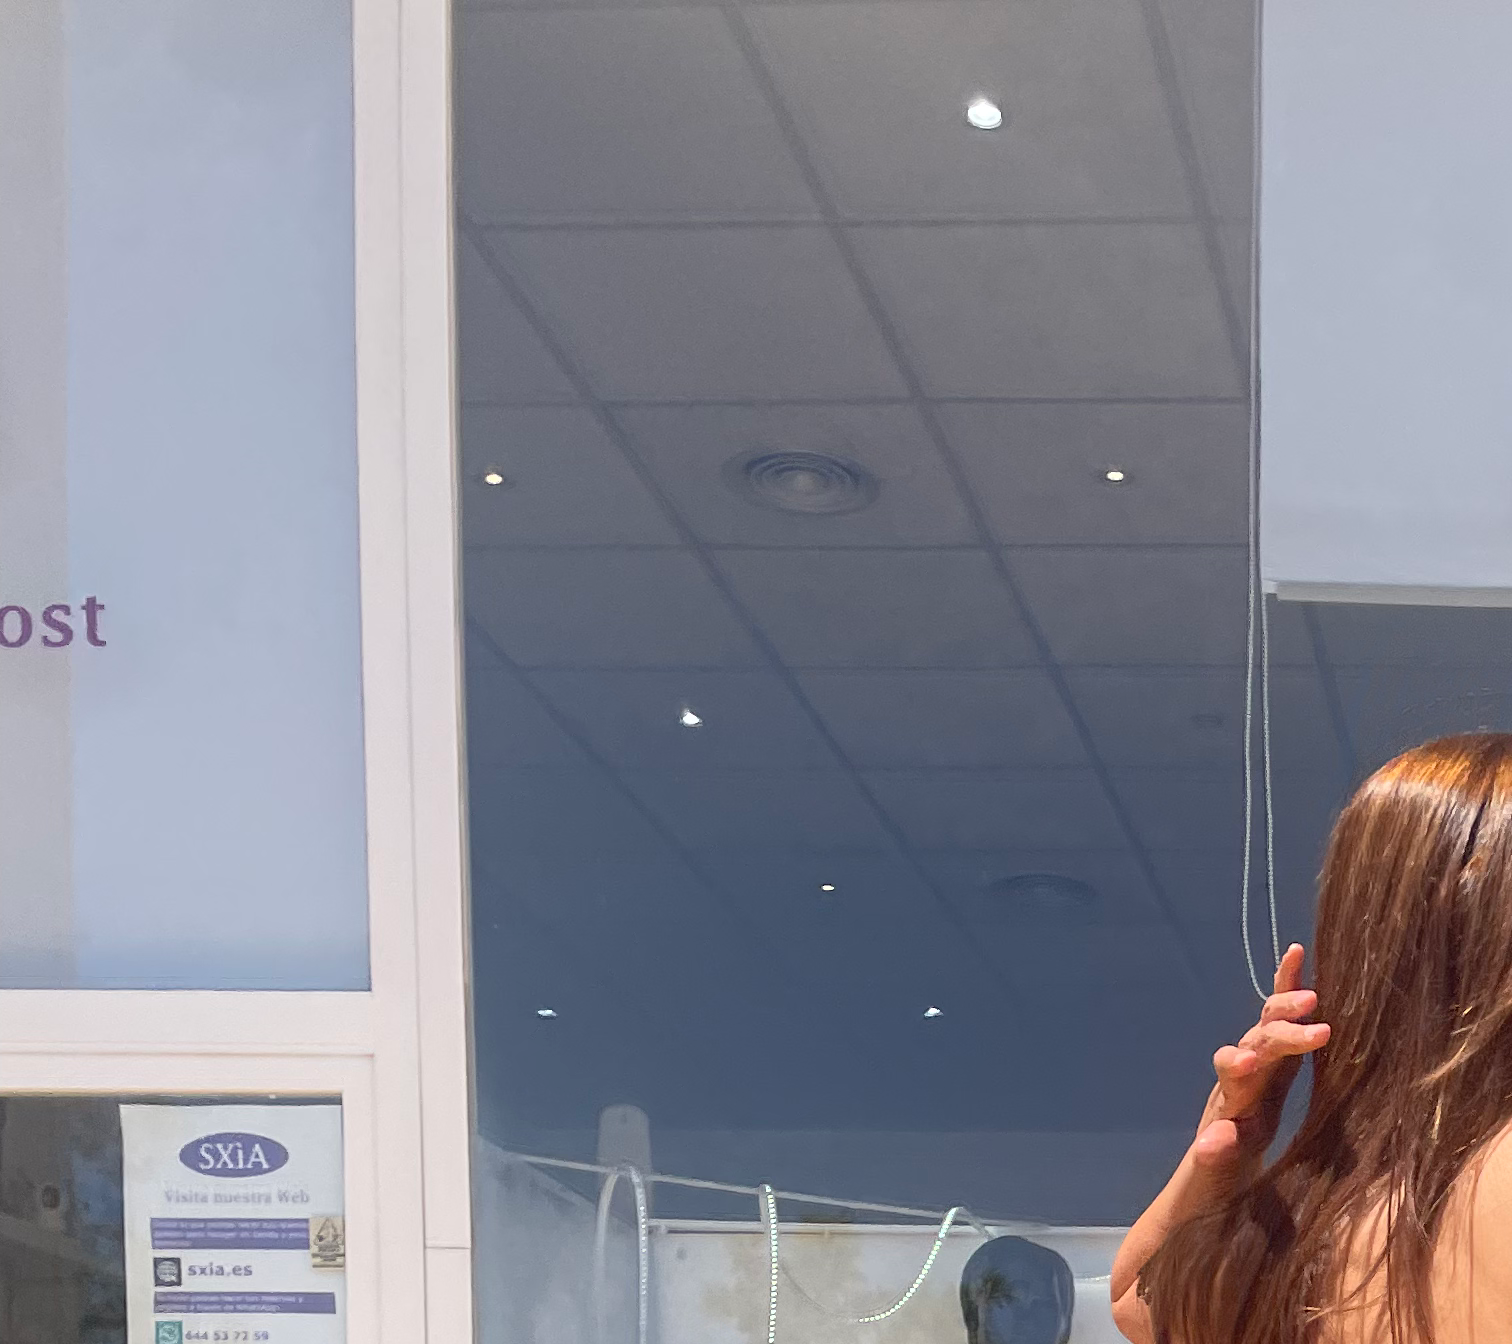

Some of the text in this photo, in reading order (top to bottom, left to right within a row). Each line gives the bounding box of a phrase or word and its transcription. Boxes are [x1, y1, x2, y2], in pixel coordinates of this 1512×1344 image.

[0, 595, 107, 648] ost
[277, 1187, 310, 1204] Web
[187, 1262, 253, 1277] sxia.es
